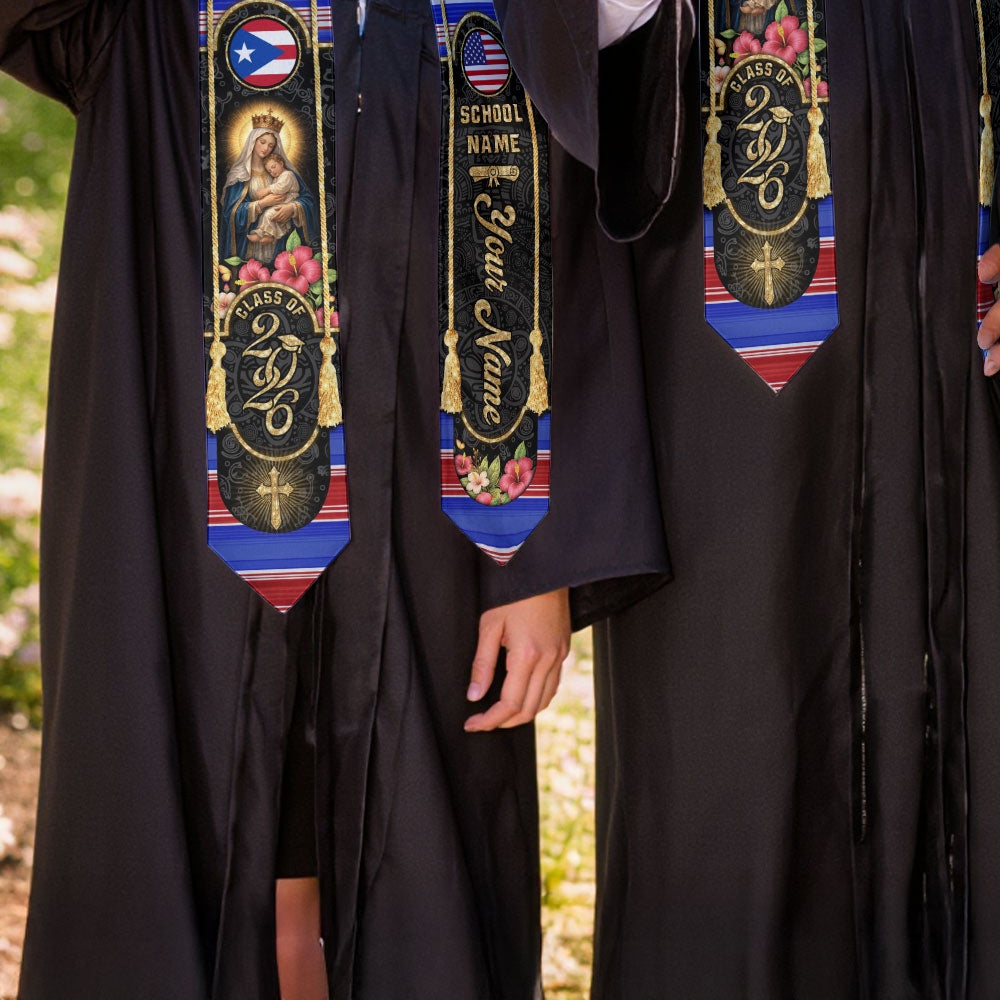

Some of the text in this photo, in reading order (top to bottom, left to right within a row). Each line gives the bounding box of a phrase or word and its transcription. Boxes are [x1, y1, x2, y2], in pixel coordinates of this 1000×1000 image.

[730, 62, 795, 93] CLASS OF
[460, 103, 523, 124] SCHOOL
[466, 133, 521, 154] NAME
[736, 84, 793, 210] 2026
[235, 290, 307, 320] CLASS OF
[474, 193, 516, 426] Your Name
[242, 312, 304, 436] 2026
